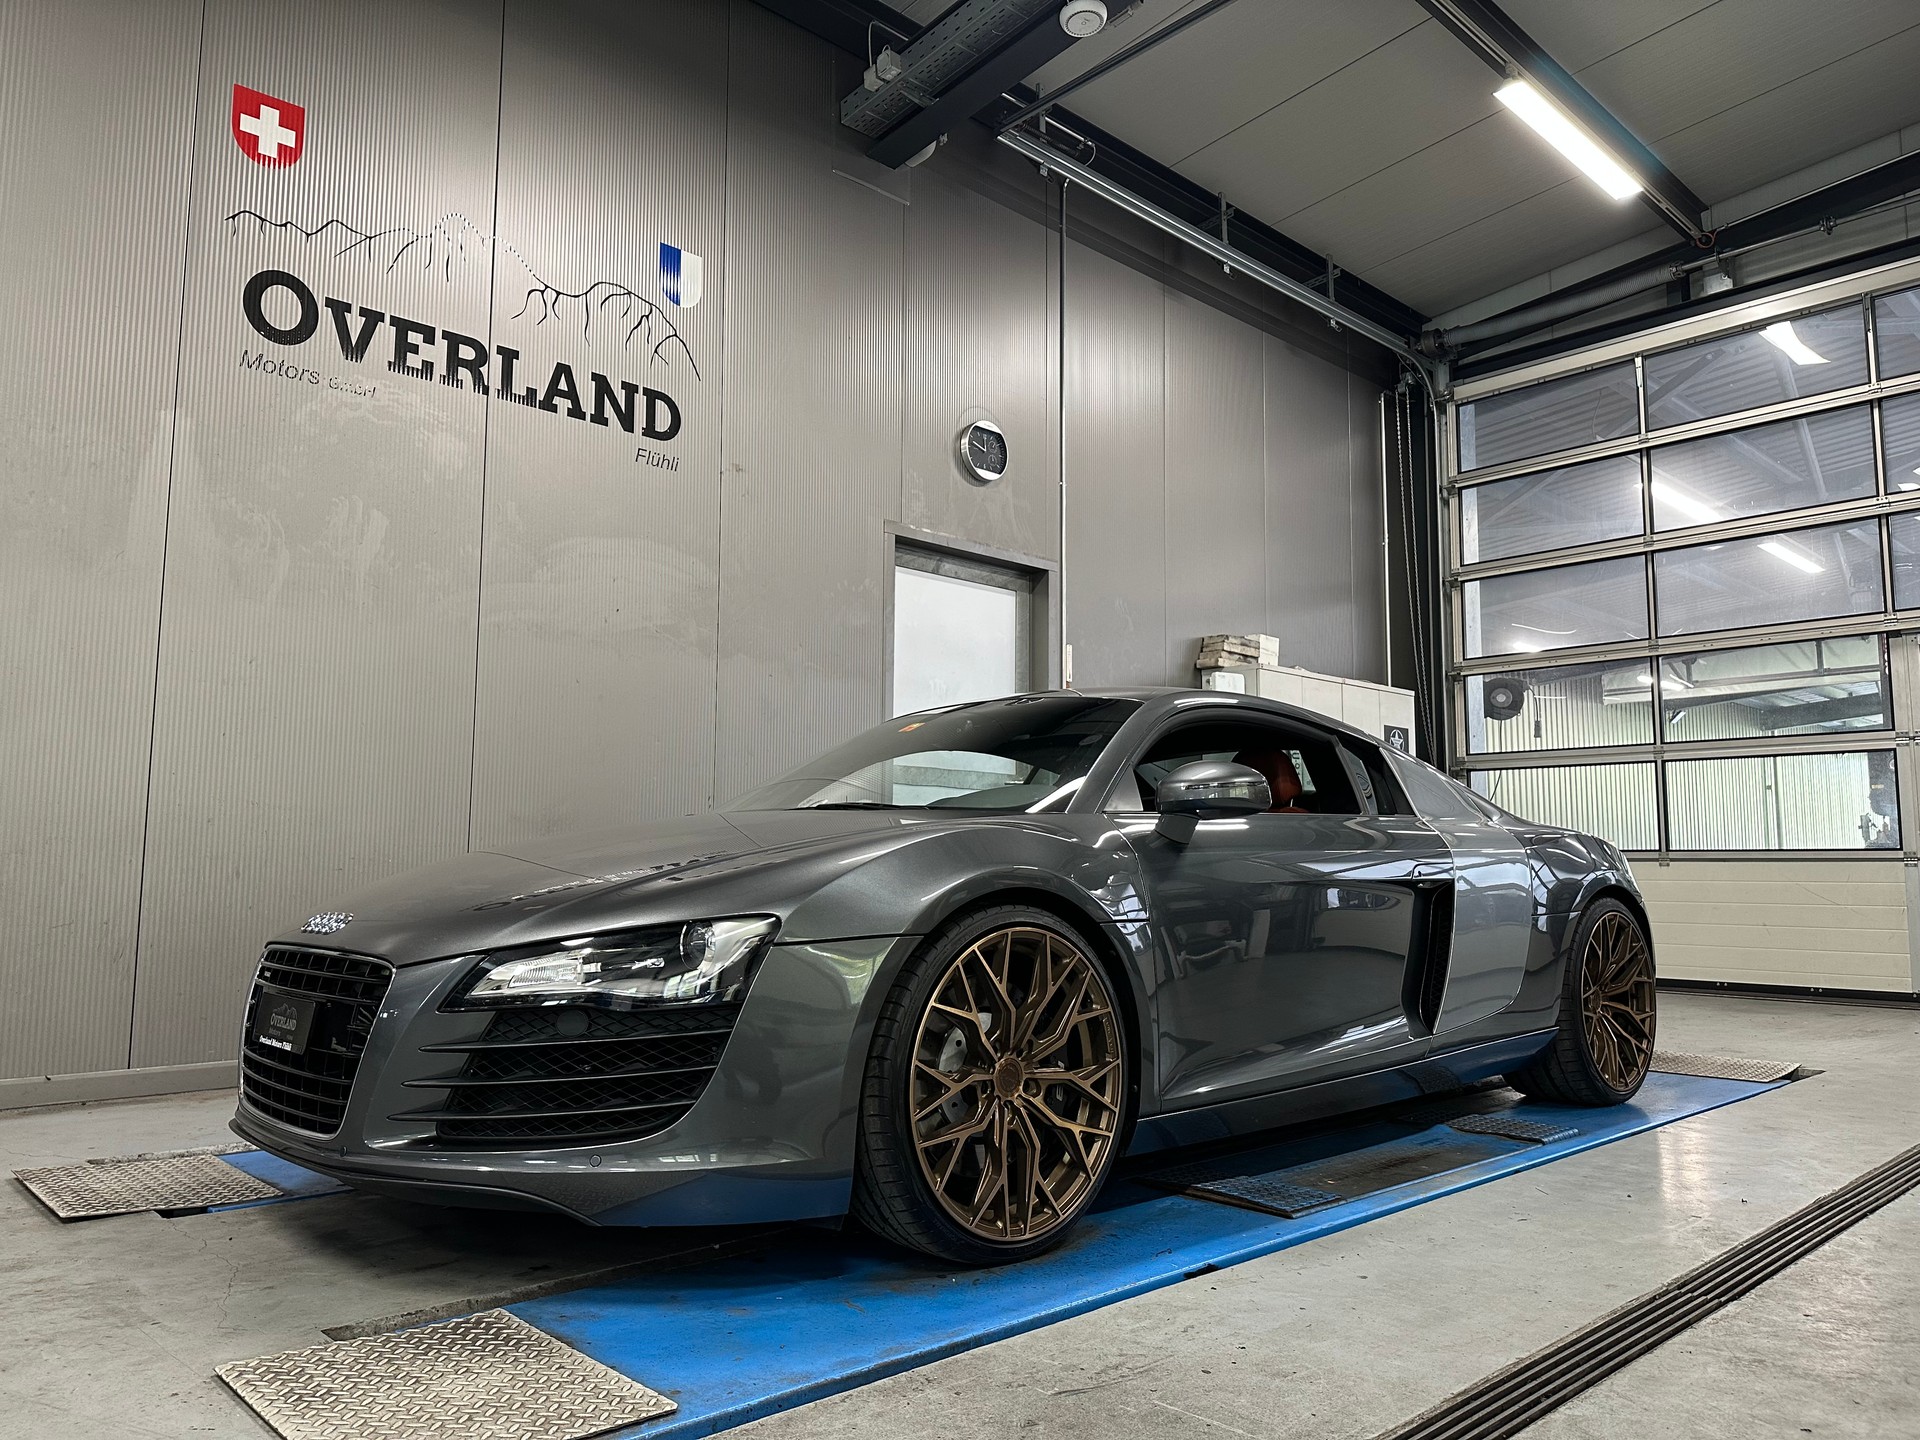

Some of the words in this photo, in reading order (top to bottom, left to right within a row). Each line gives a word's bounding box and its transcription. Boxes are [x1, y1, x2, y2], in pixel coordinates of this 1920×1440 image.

[239, 349, 320, 385] Motors
[242, 269, 682, 442] OVERLAND
[634, 447, 681, 473] Flühli
